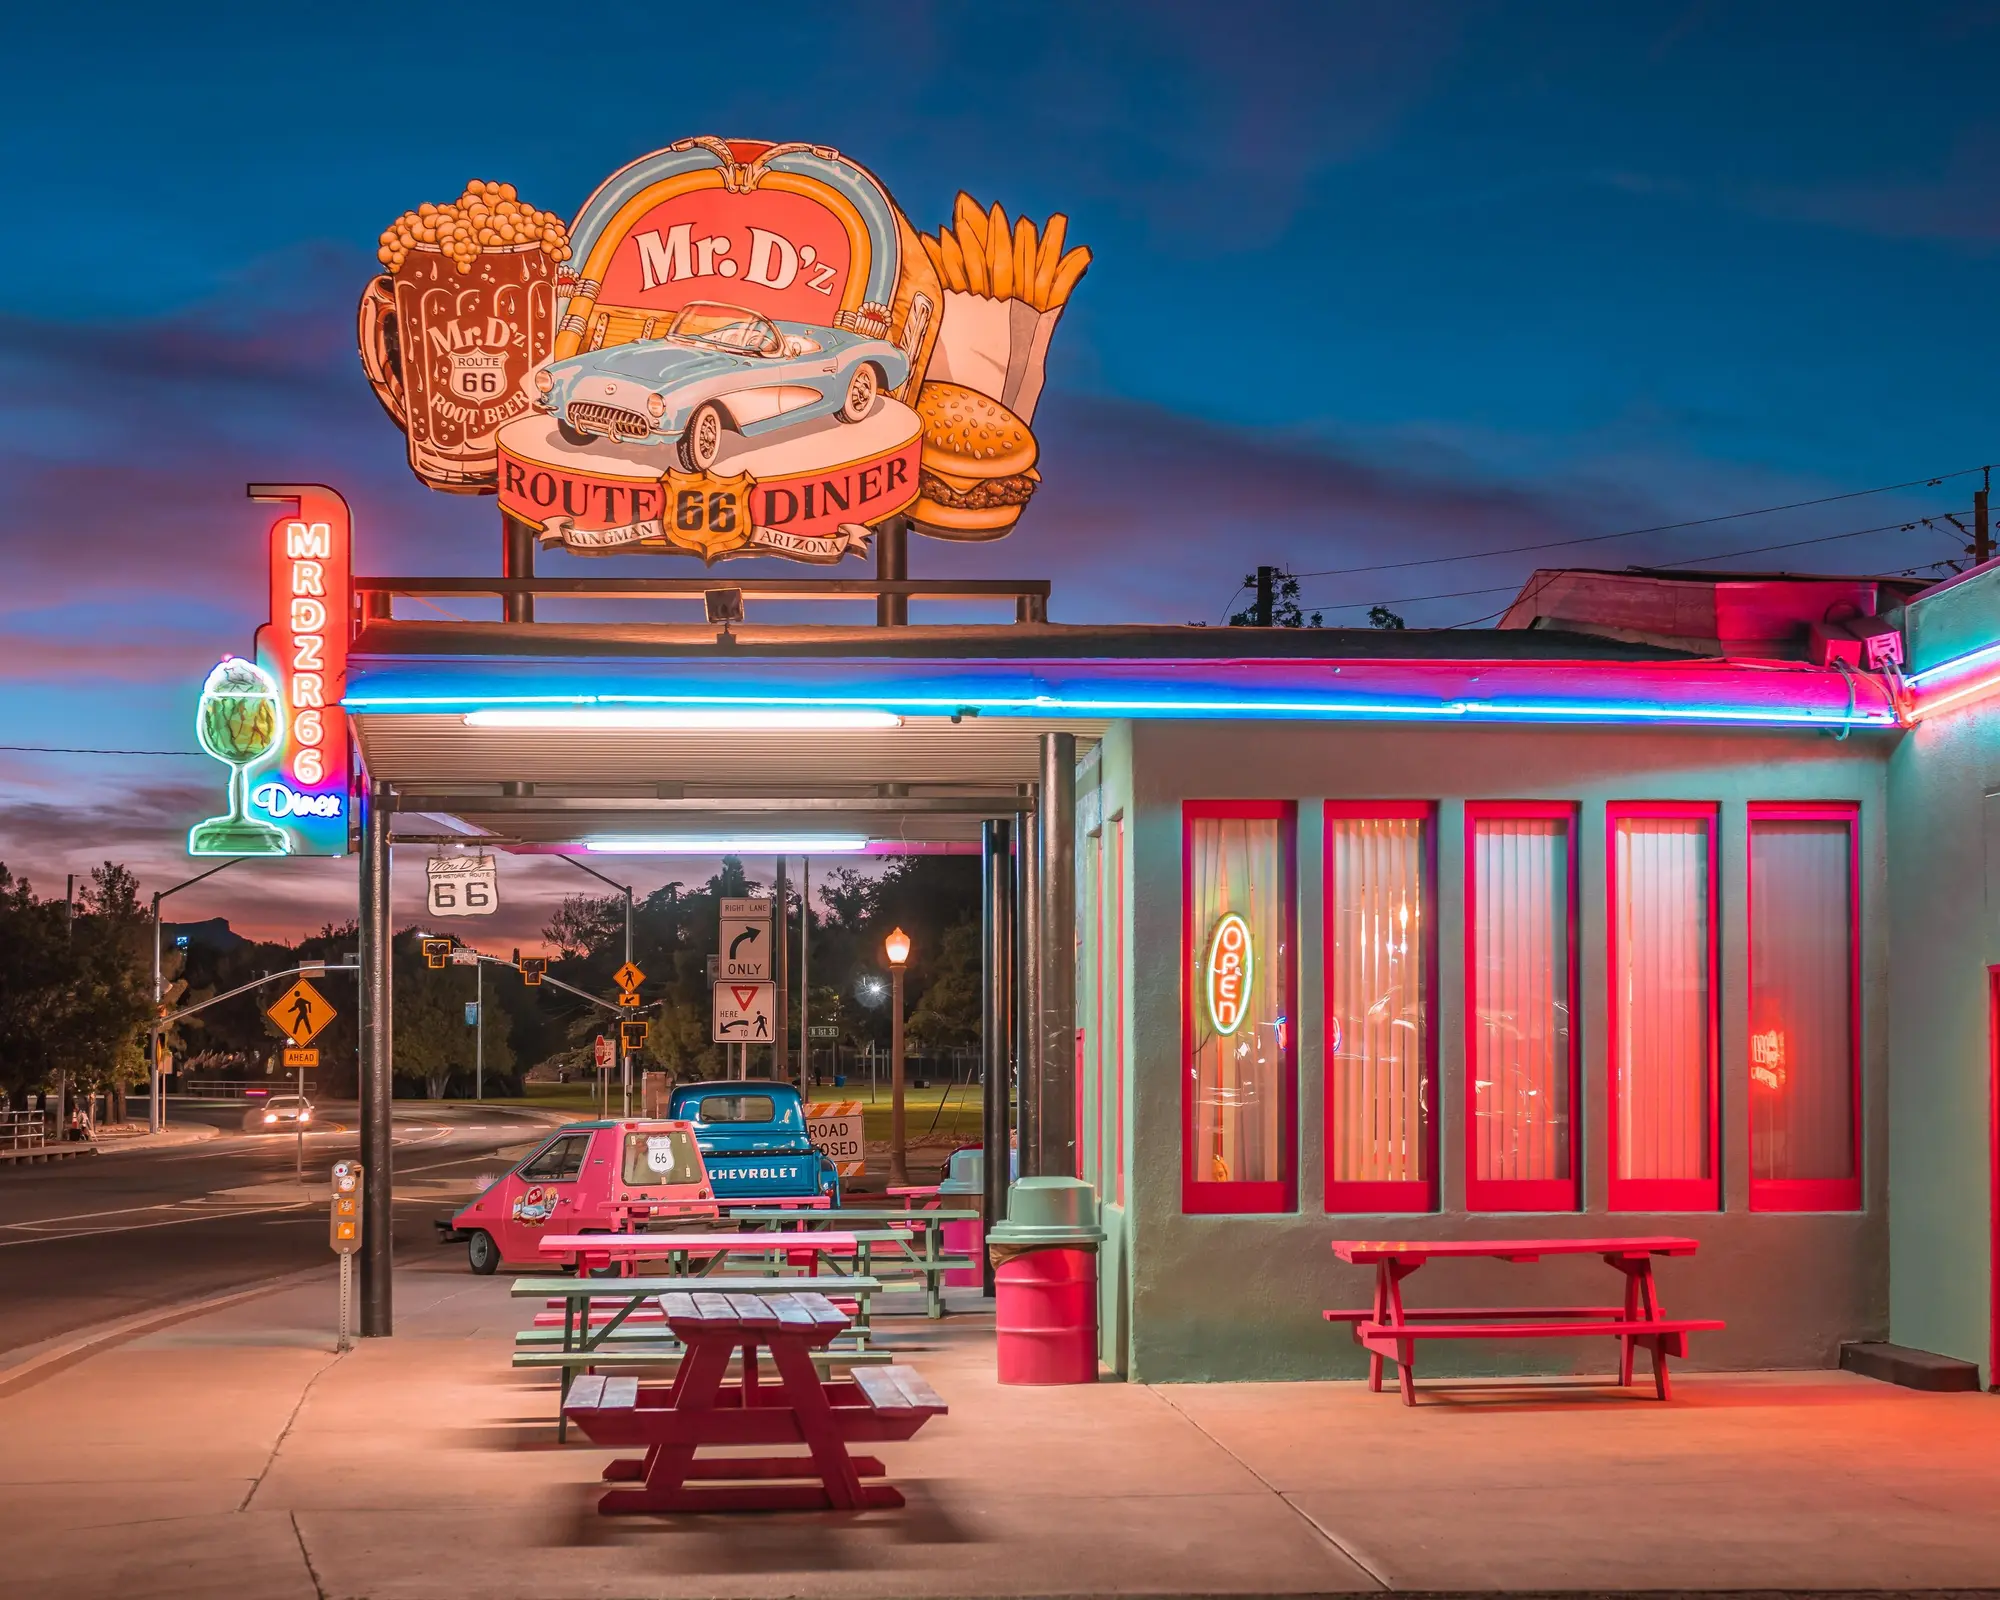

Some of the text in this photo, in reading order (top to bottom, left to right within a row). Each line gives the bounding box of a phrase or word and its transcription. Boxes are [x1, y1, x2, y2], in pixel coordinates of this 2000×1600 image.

[632, 222, 838, 297] Mr. D'z
[427, 318, 483, 358] Mr.
[458, 357, 500, 367] ROUTE
[462, 372, 497, 393] 66
[430, 390, 529, 425] ROOT BEER
[505, 457, 909, 532] ROUTE 66 DINER
[567, 522, 841, 554] KINGMAN ARIZONA
[252, 782, 342, 818] Diner
[434, 881, 489, 908] 66
[724, 904, 767, 912] RIGHT LANE
[728, 963, 762, 975] ONLY
[720, 1010, 738, 1018] HERE
[740, 1029, 749, 1037] TO
[829, 1027, 836, 1035] St
[288, 1053, 315, 1062] AHEAD
[808, 1123, 849, 1138] ROAD
[655, 1152, 667, 1164] 66
[708, 1167, 798, 1180] CHEVROLET
